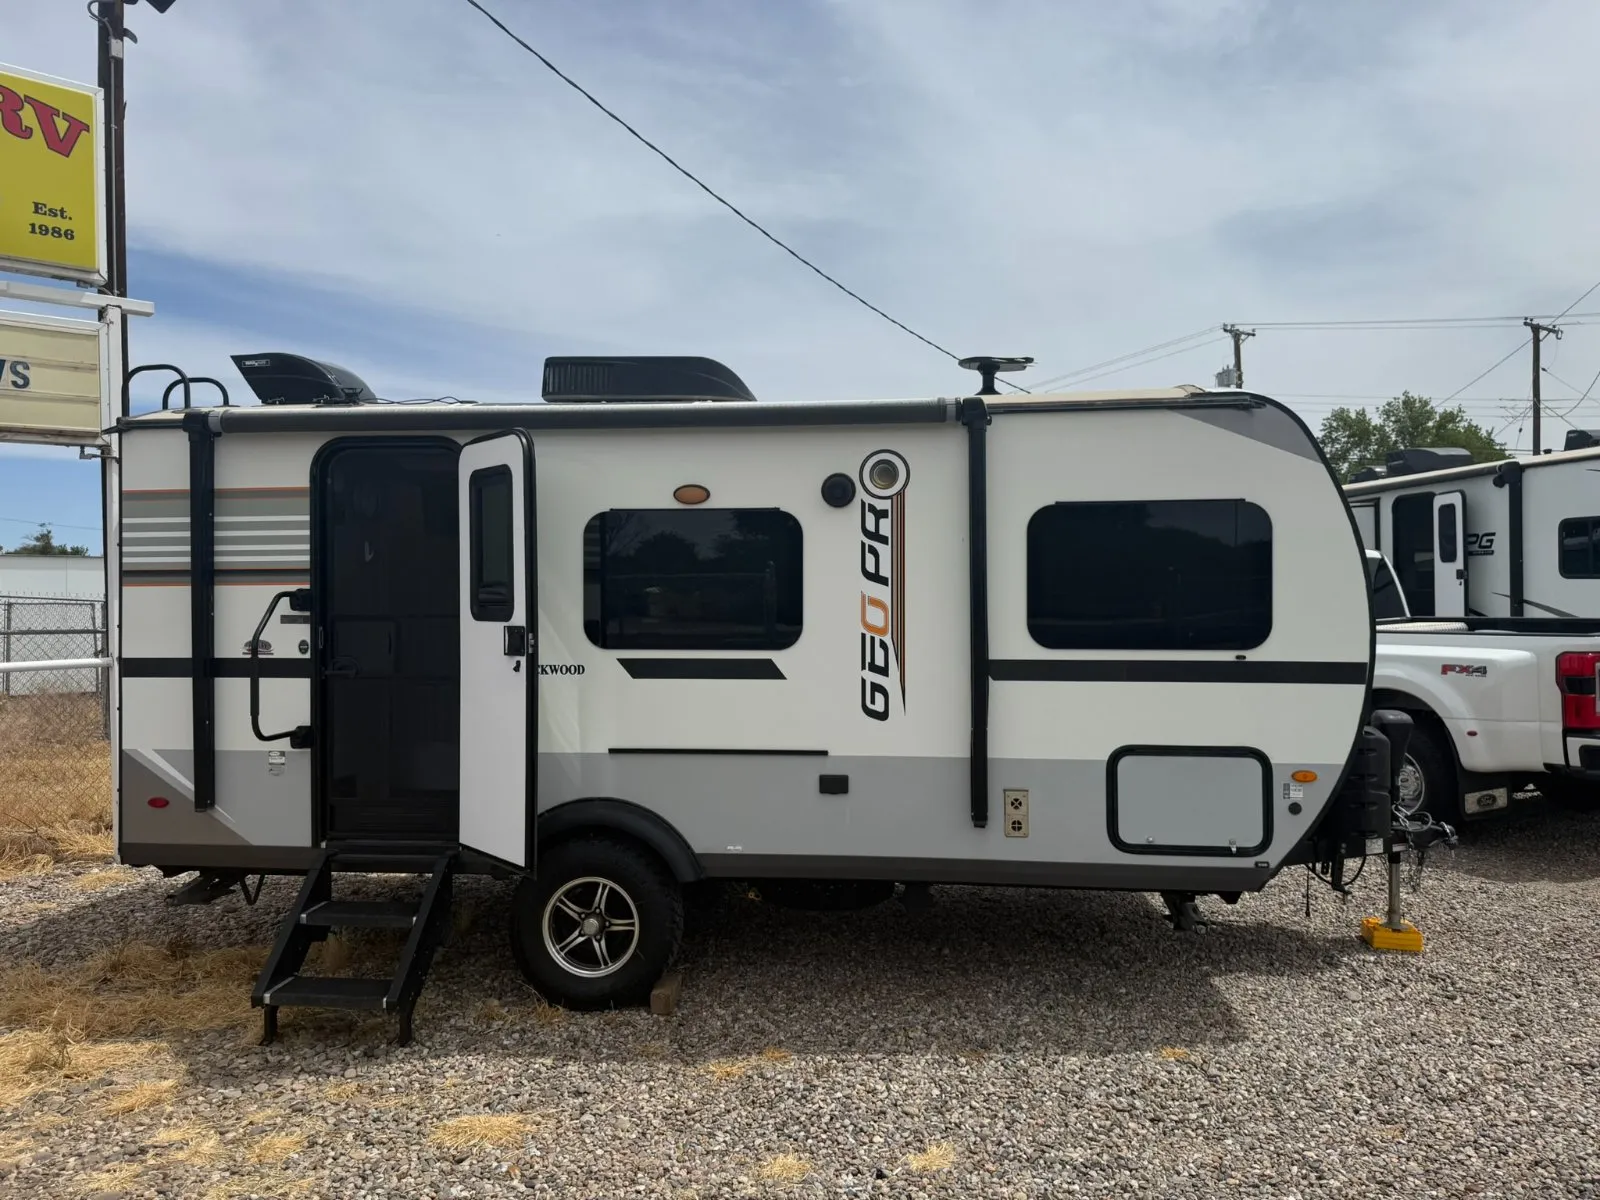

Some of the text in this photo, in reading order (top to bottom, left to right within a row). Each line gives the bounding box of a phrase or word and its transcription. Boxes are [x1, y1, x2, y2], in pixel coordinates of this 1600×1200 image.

[32, 201, 73, 221] Est.
[28, 222, 75, 241] 1986
[861, 591, 890, 722] GEO
[1441, 664, 1488, 676] FX4
